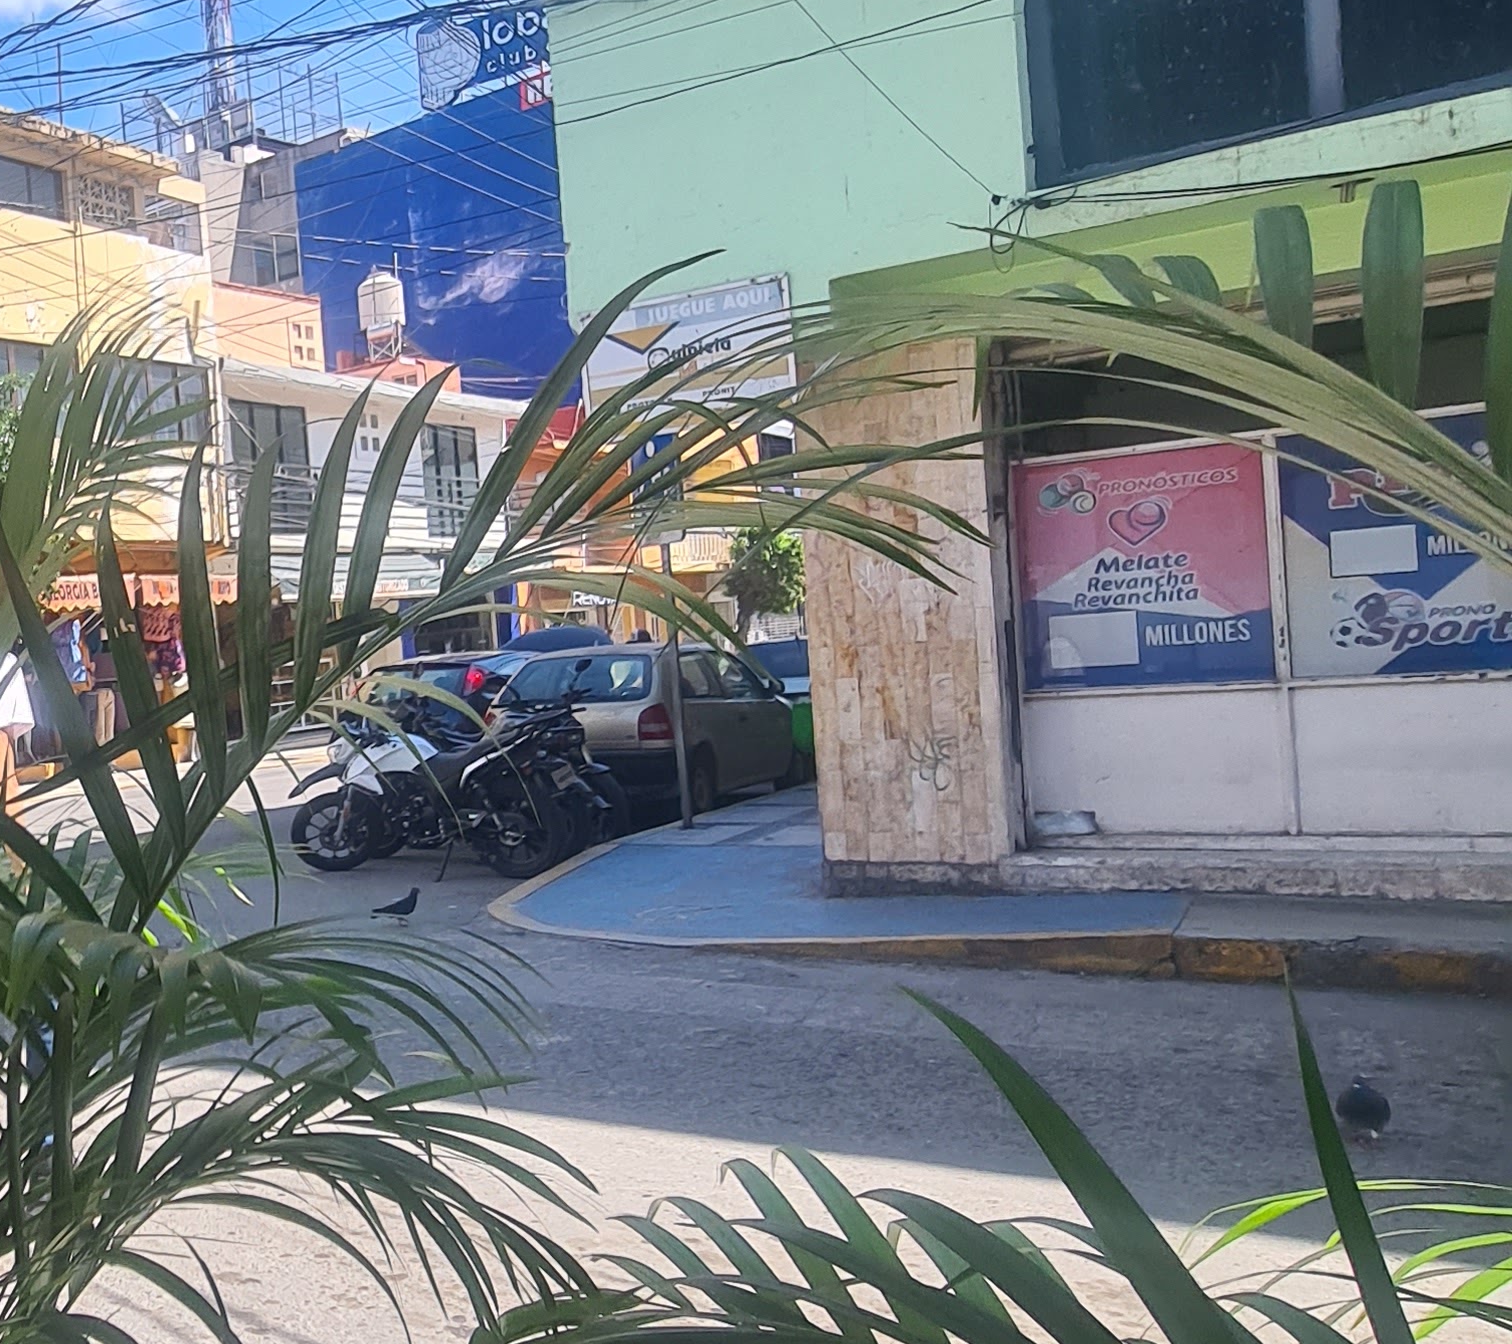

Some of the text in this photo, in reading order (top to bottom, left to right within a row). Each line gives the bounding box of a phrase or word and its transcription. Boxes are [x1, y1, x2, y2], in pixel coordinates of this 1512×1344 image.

[647, 297, 717, 323] JUEGUE
[1098, 468, 1238, 496] PRONÓSTICOS
[1095, 552, 1190, 575] Melate
[1087, 569, 1195, 593] Revancha
[1074, 584, 1200, 609] Revanchita
[1428, 603, 1497, 618] PRONO
[1145, 620, 1251, 647] MILLONES
